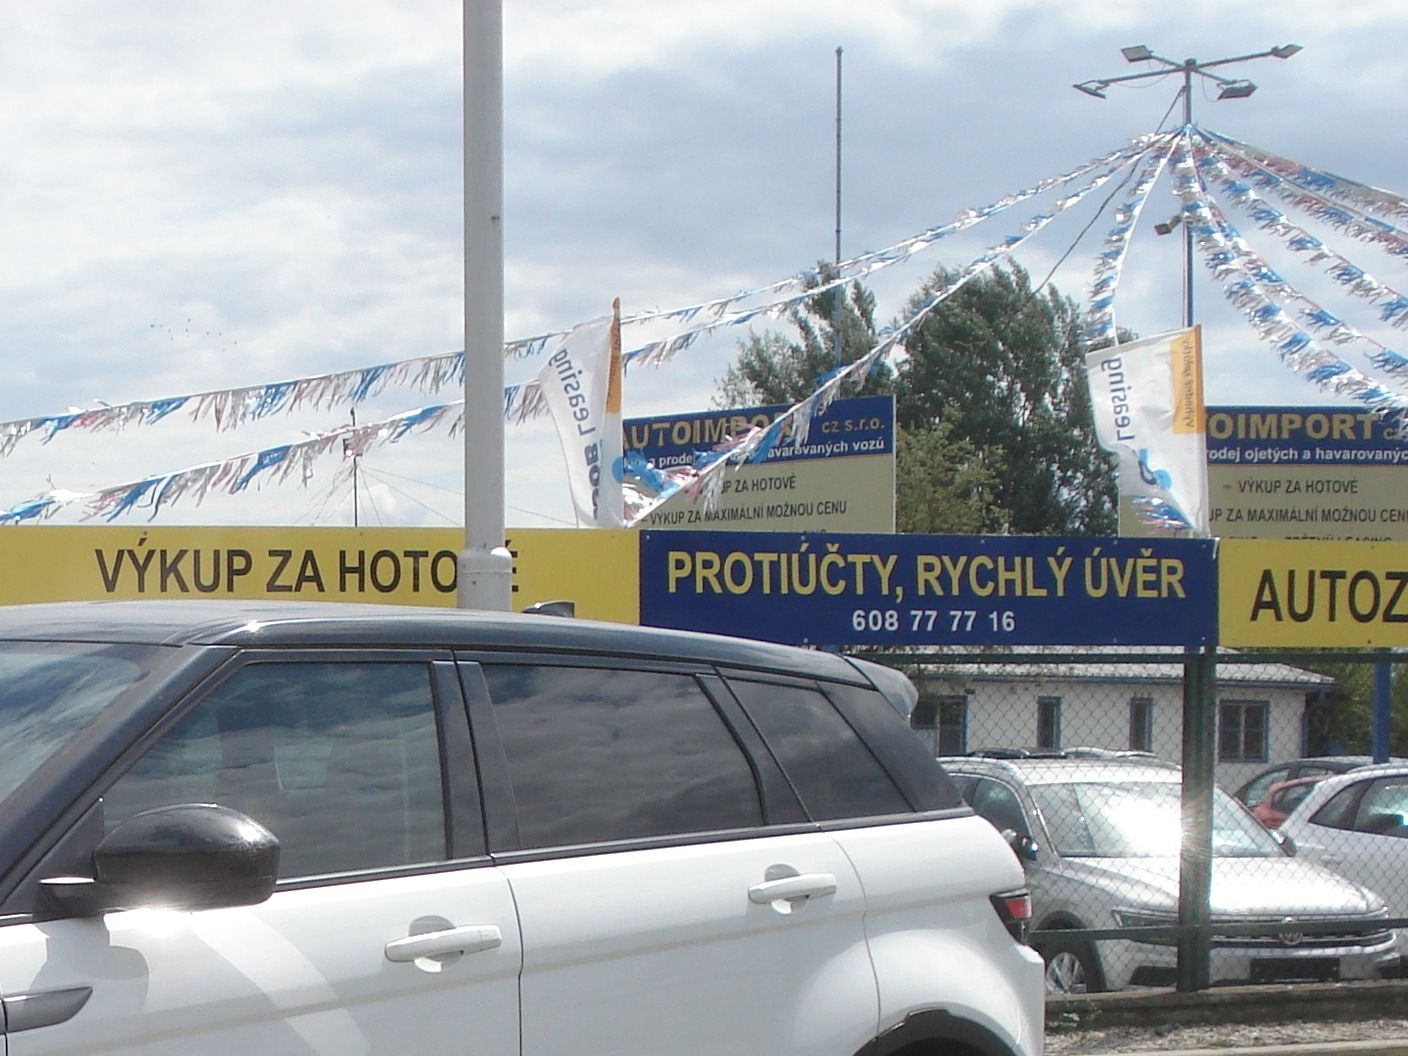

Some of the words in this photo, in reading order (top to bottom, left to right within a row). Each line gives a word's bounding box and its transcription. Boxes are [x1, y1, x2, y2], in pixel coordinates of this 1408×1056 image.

[844, 417, 886, 431] s.r.o.
[658, 453, 694, 471] prode
[767, 440, 849, 459] avarovaných
[852, 436, 885, 451] vozů
[1244, 445, 1298, 463] ojetých
[1302, 448, 1311, 460] a
[734, 481, 750, 493] ZA
[751, 474, 797, 492] HOTOVÉ
[1237, 477, 1282, 494] VÝKUP
[1284, 479, 1302, 494] ZA
[1305, 477, 1358, 494] HOTOVÉ
[687, 510, 702, 524] ZA
[766, 500, 814, 518] MOŽNOU
[816, 500, 847, 515] CENU
[1226, 508, 1243, 522] ZA
[1247, 505, 1319, 522] MAXIMÁLNÍ
[1321, 503, 1377, 522] MOŽNOU
[94, 536, 254, 594] VÝKUP
[266, 549, 326, 593] ZA
[667, 542, 905, 604] PROTIÚČTY,
[917, 545, 1073, 599] RYCHLÝ
[1085, 550, 1187, 599] ÚVĚR
[851, 609, 899, 633] 608
[909, 610, 939, 633] 77
[949, 610, 977, 633] 77
[988, 610, 1016, 633] 16
